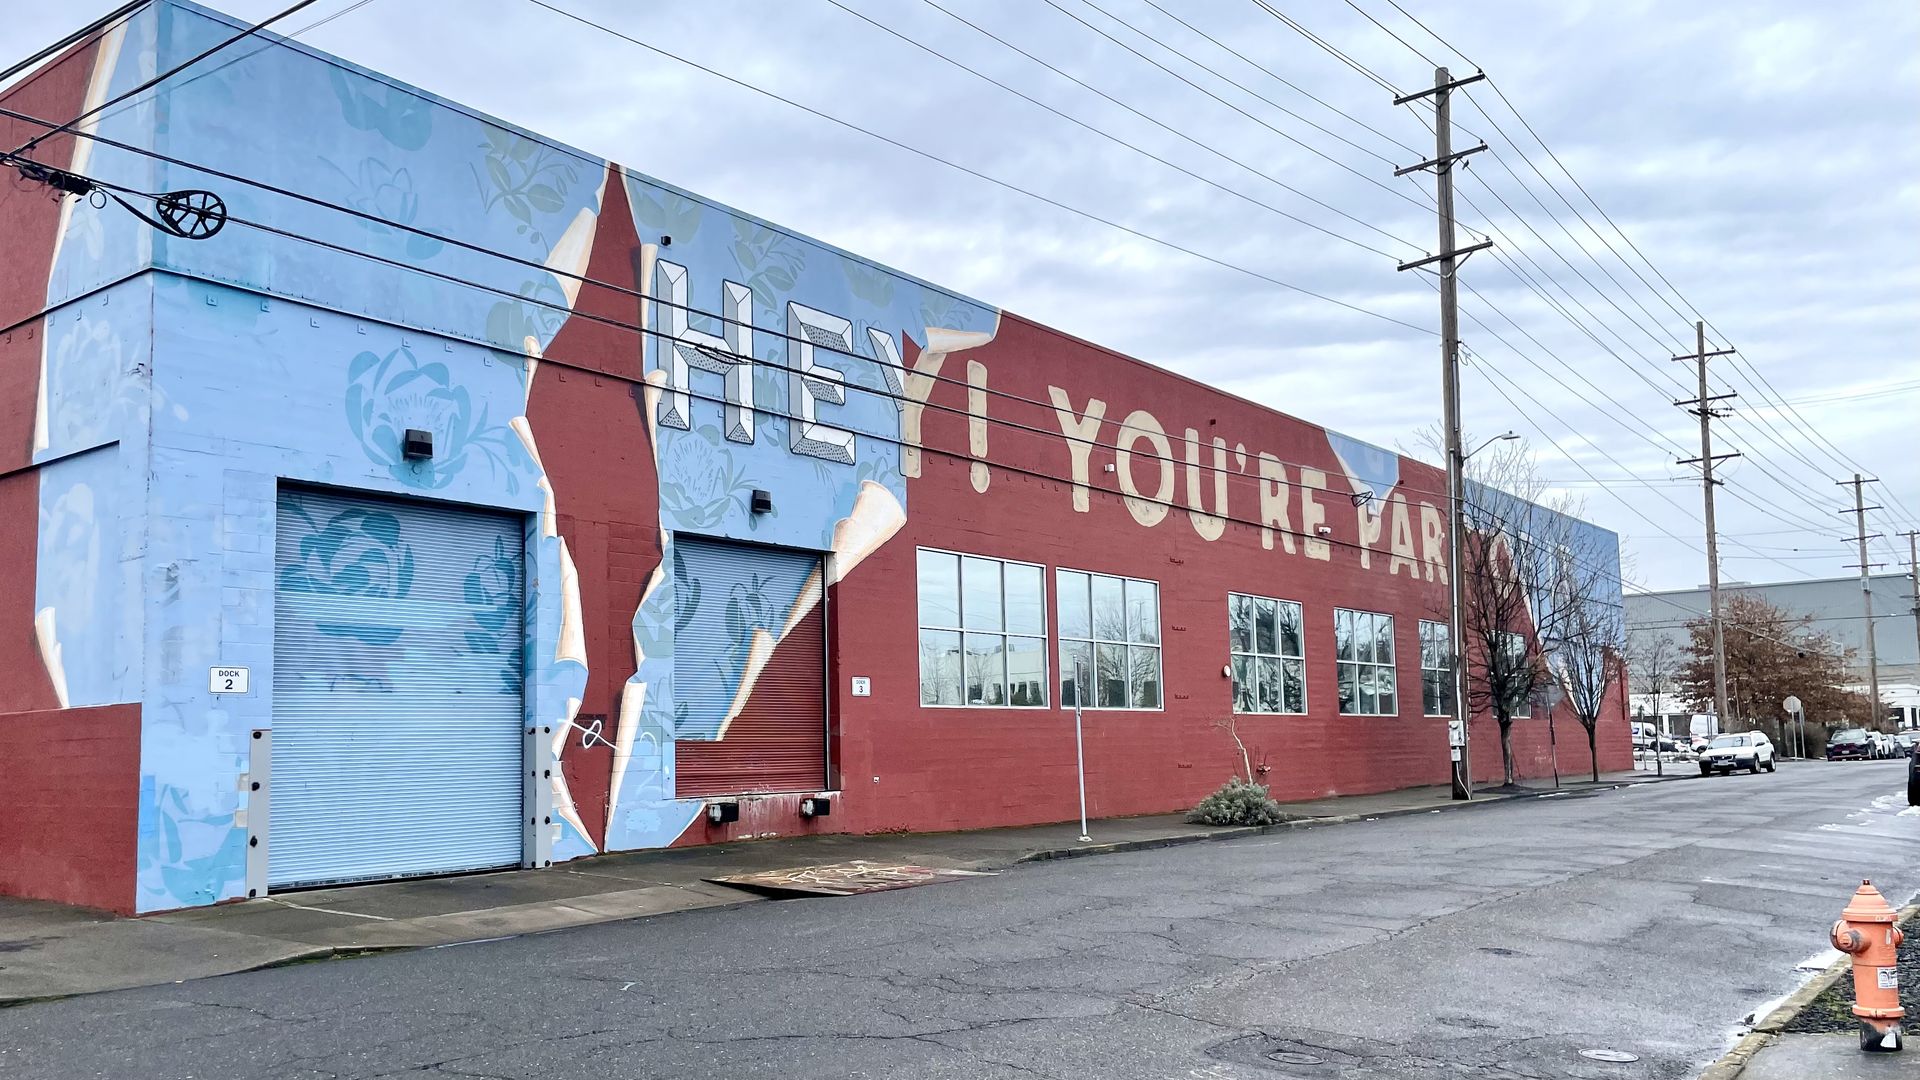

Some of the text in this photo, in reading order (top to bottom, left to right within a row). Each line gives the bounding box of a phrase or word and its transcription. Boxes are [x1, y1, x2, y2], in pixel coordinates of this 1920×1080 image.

[656, 258, 988, 494] HEY!
[1047, 384, 1331, 562] YOU'RE
[1357, 492, 1462, 587] PAR
[225, 679, 233, 690] 2
[859, 685, 864, 693] 3
